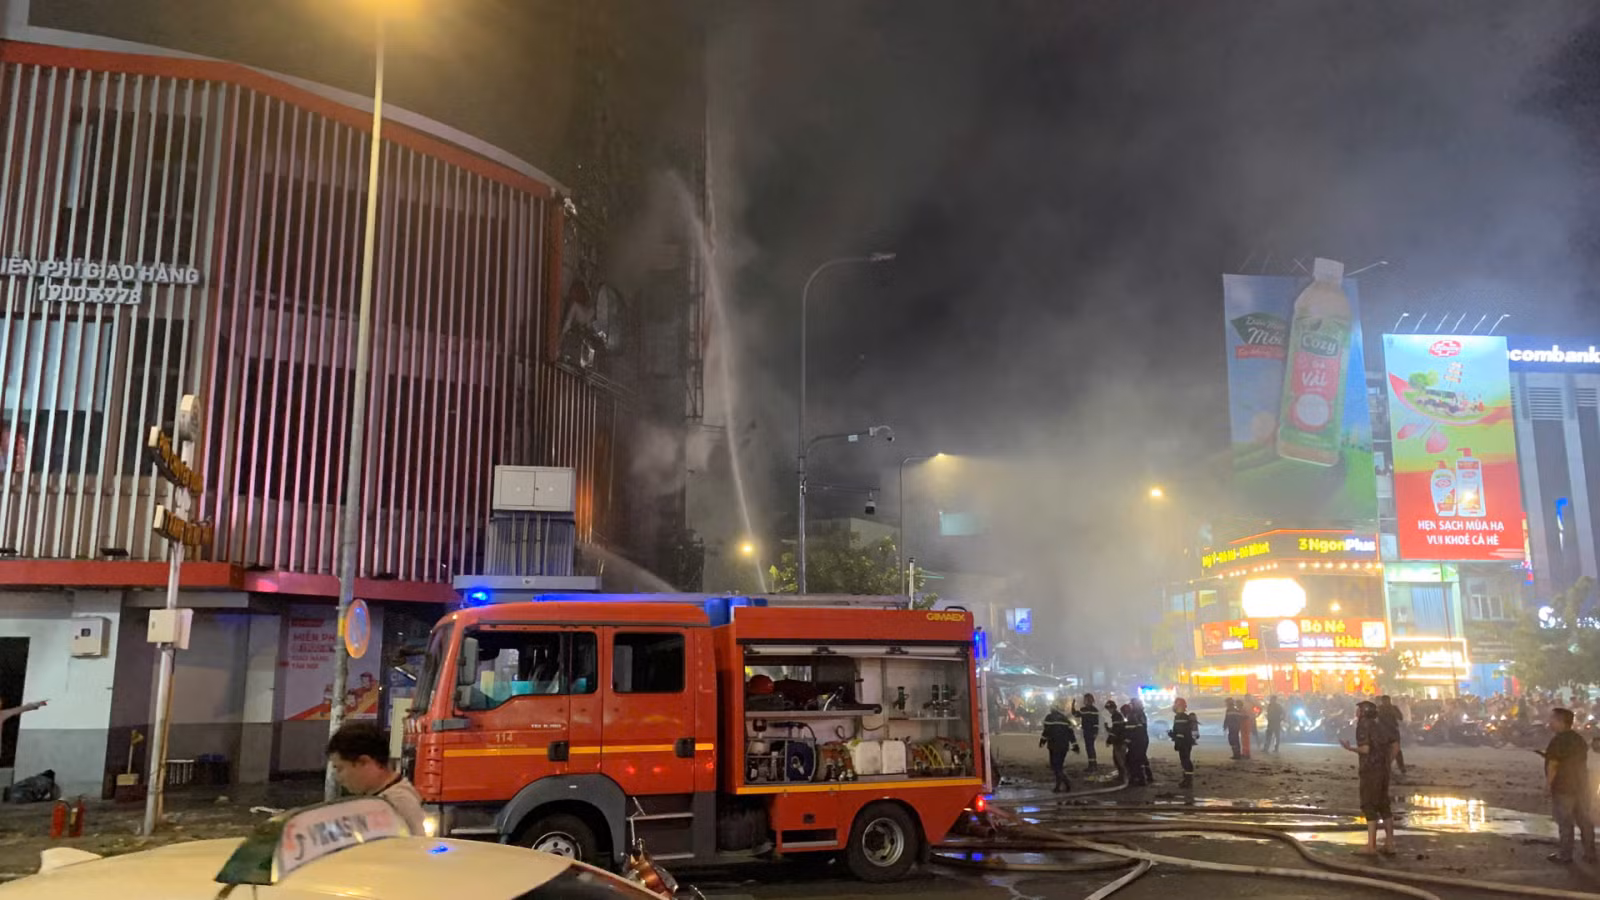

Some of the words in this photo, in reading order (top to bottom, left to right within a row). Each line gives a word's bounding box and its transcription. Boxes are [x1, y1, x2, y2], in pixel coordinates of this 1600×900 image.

[86, 262, 134, 281] GIAO
[142, 262, 200, 284] HÀNG
[1302, 333, 1337, 355] Cozy
[1439, 519, 1464, 532] SẠCH
[1465, 518, 1489, 531] MÙA
[1490, 520, 1505, 532] HẠ
[1426, 534, 1443, 545] VUI
[1301, 619, 1322, 633] Bò
[321, 632, 337, 642] PH
[495, 732, 513, 743] 114
